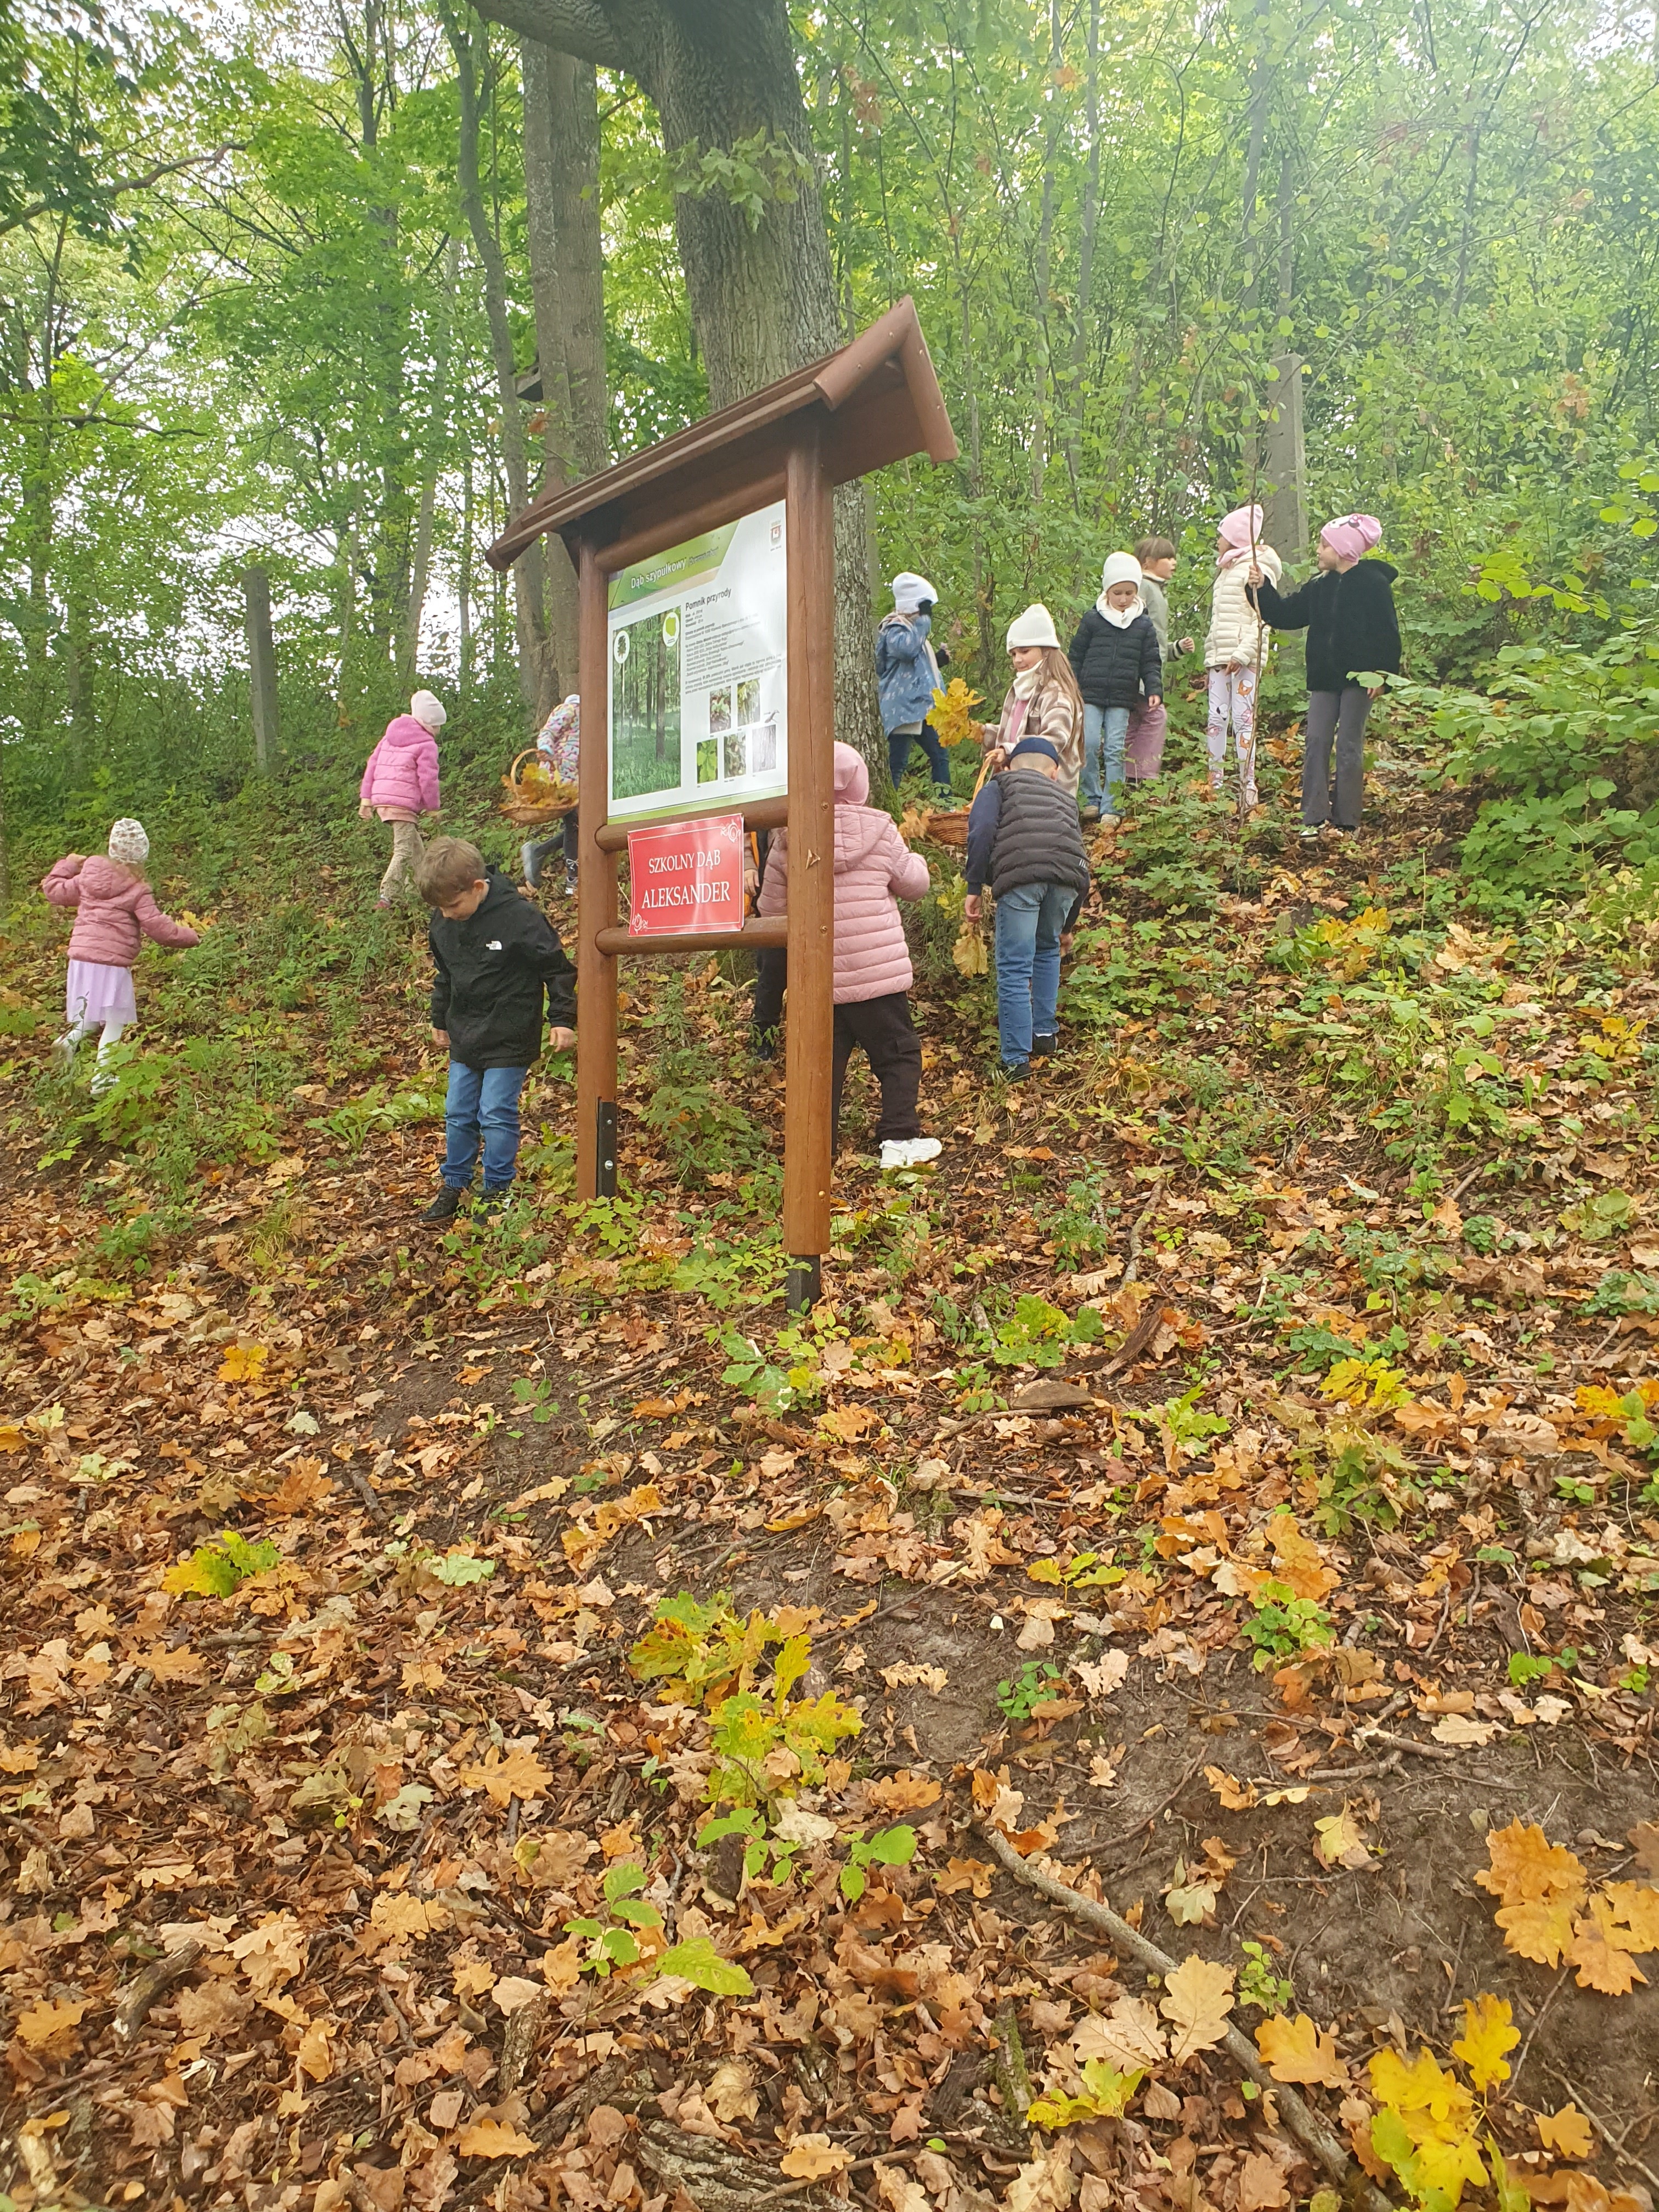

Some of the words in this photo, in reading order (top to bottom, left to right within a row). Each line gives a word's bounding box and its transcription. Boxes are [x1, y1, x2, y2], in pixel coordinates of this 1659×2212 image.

[631, 575, 644, 589] Dąb
[685, 596, 706, 611] Pomnik
[707, 588, 731, 606] przyrody
[648, 853, 695, 874] SZKOLNY
[697, 849, 721, 870] DĄB
[641, 881, 731, 909] ALEKSANDER
